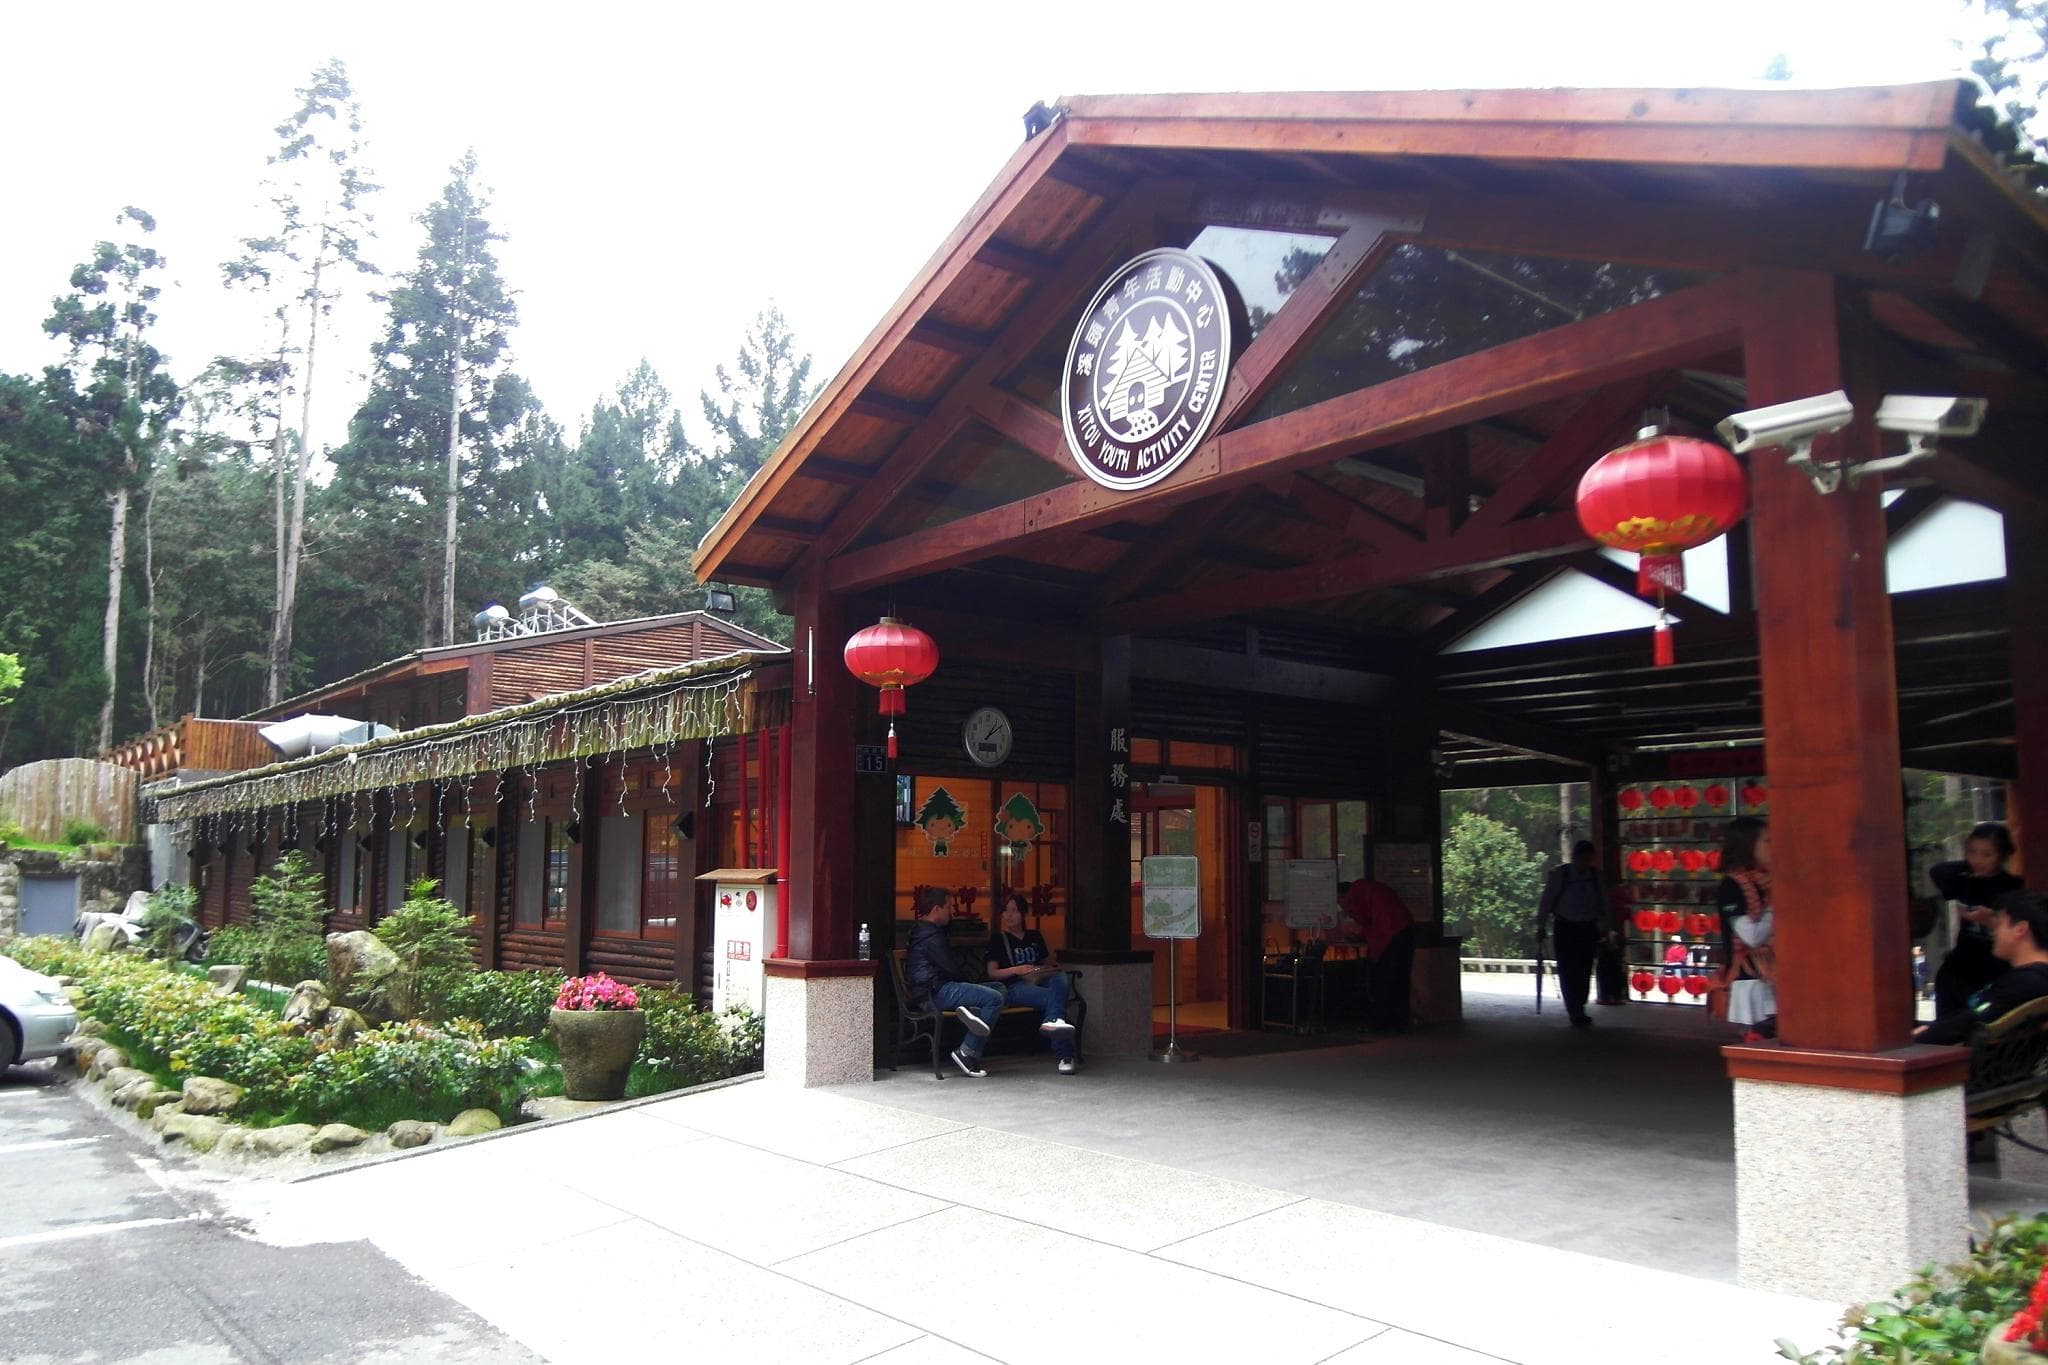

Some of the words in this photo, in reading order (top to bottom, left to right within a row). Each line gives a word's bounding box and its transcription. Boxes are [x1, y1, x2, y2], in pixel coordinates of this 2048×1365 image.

[1076, 265, 1214, 377] 溪頭青年活動中心
[1077, 402, 1101, 448] XITOU
[1097, 442, 1130, 471] YOUTH
[1136, 415, 1192, 471] ACTIVITY
[1188, 348, 1216, 413] CENTER
[866, 756, 883, 770] 15
[1110, 727, 1129, 823] 服務處
